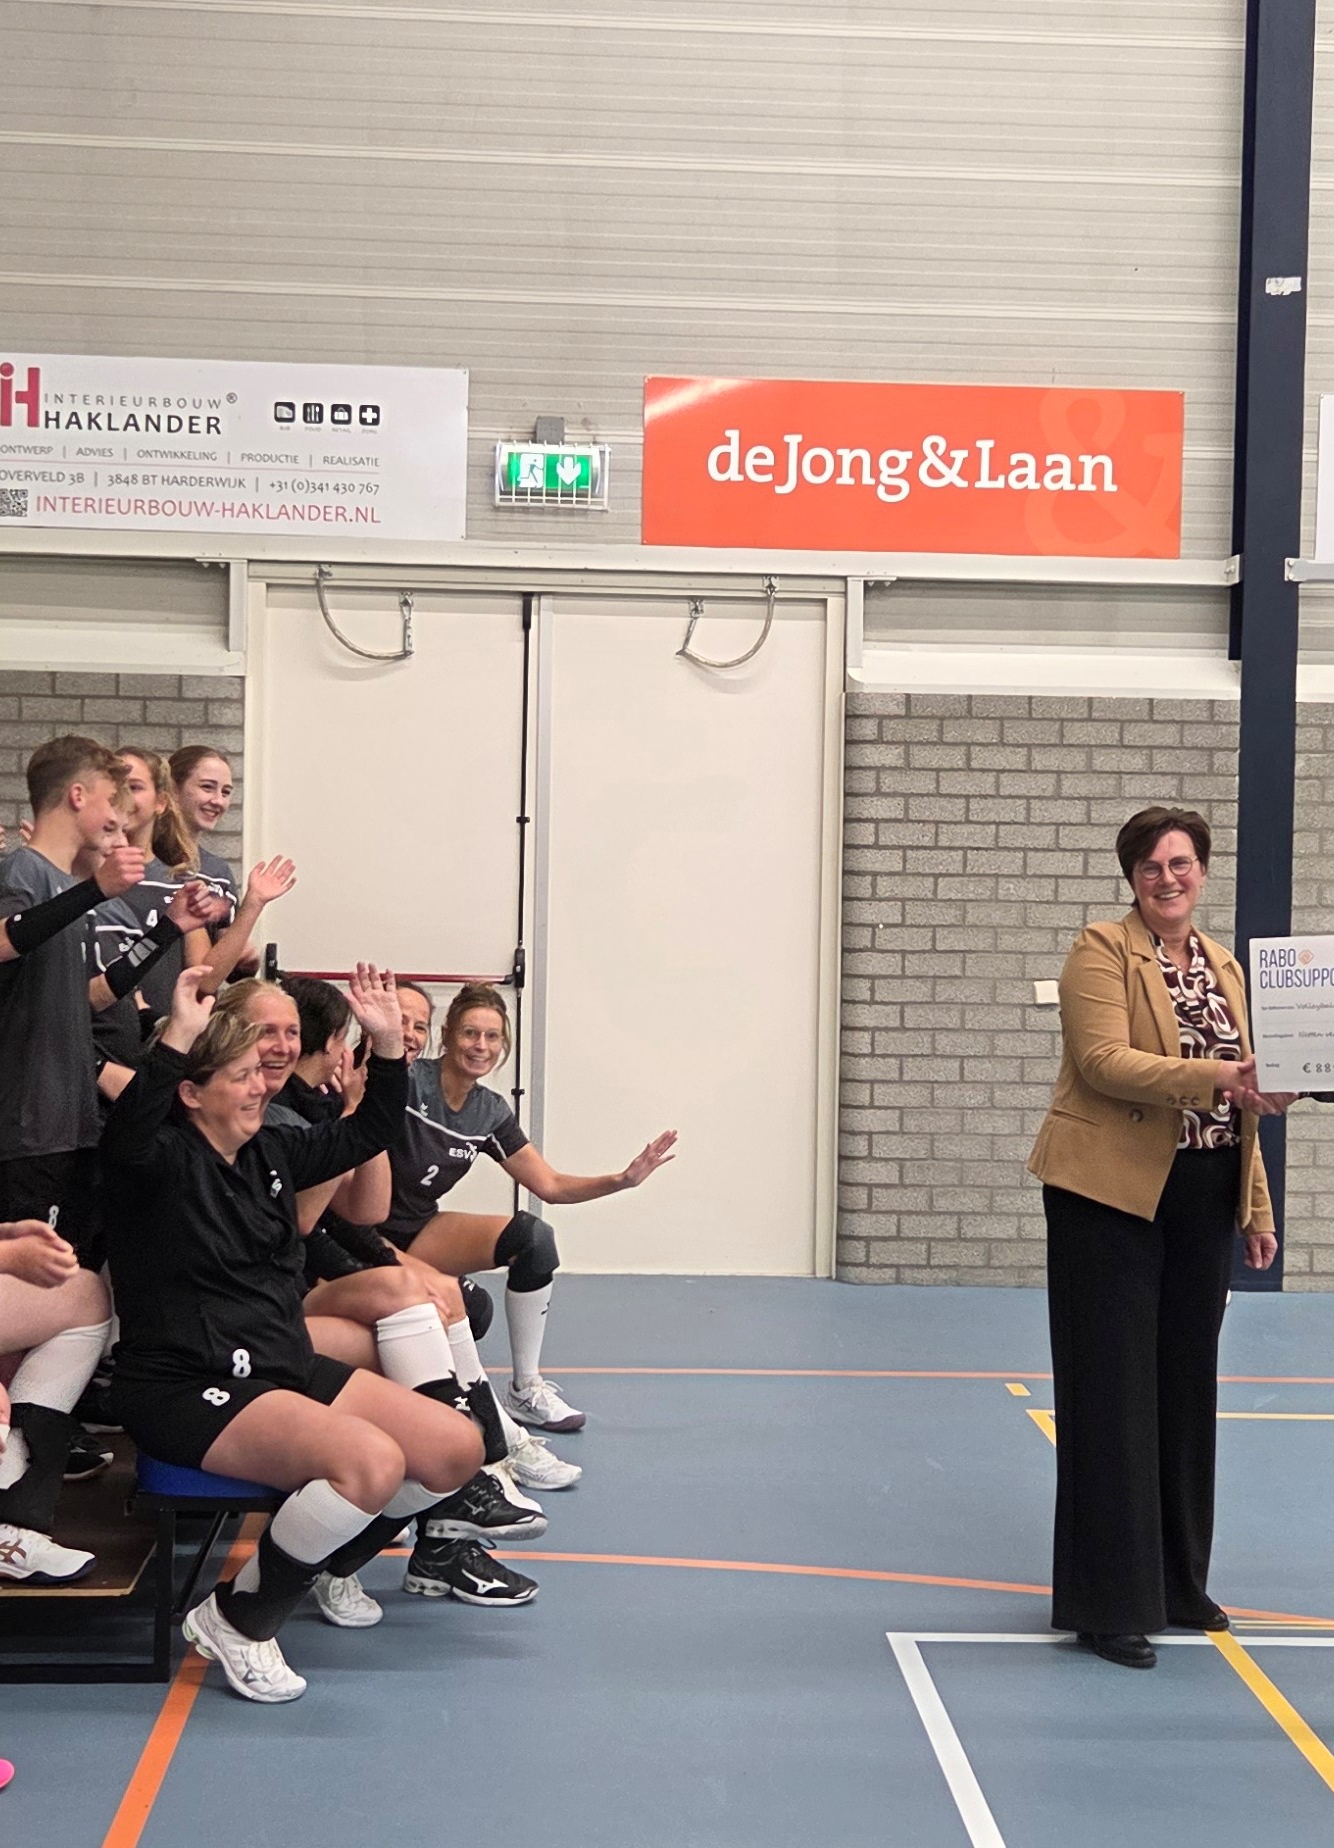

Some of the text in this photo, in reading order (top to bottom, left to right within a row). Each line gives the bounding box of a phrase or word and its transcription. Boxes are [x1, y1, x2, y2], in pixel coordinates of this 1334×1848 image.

[45, 410, 222, 435] HAKLANDER
[0, 443, 54, 456] ONTWERP
[75, 446, 114, 458] ADVIES
[136, 449, 218, 462] ONTWIKKELING
[241, 452, 300, 464] PRODUCTIE
[323, 455, 380, 468] REALISATIE
[68, 472, 85, 486] 3B
[107, 473, 246, 489] 3848 BT HARDERWIJK
[269, 481, 288, 492] +31
[333, 481, 355, 494] 430
[358, 483, 380, 496] 767
[36, 495, 382, 524] INTERIEURBOUW-HAKLANDER.NL
[1259, 948, 1296, 968] RABO
[448, 1147, 471, 1159] ESV
[420, 1164, 440, 1186] 2
[232, 1348, 252, 1378] 8
[202, 1387, 231, 1407] 8
